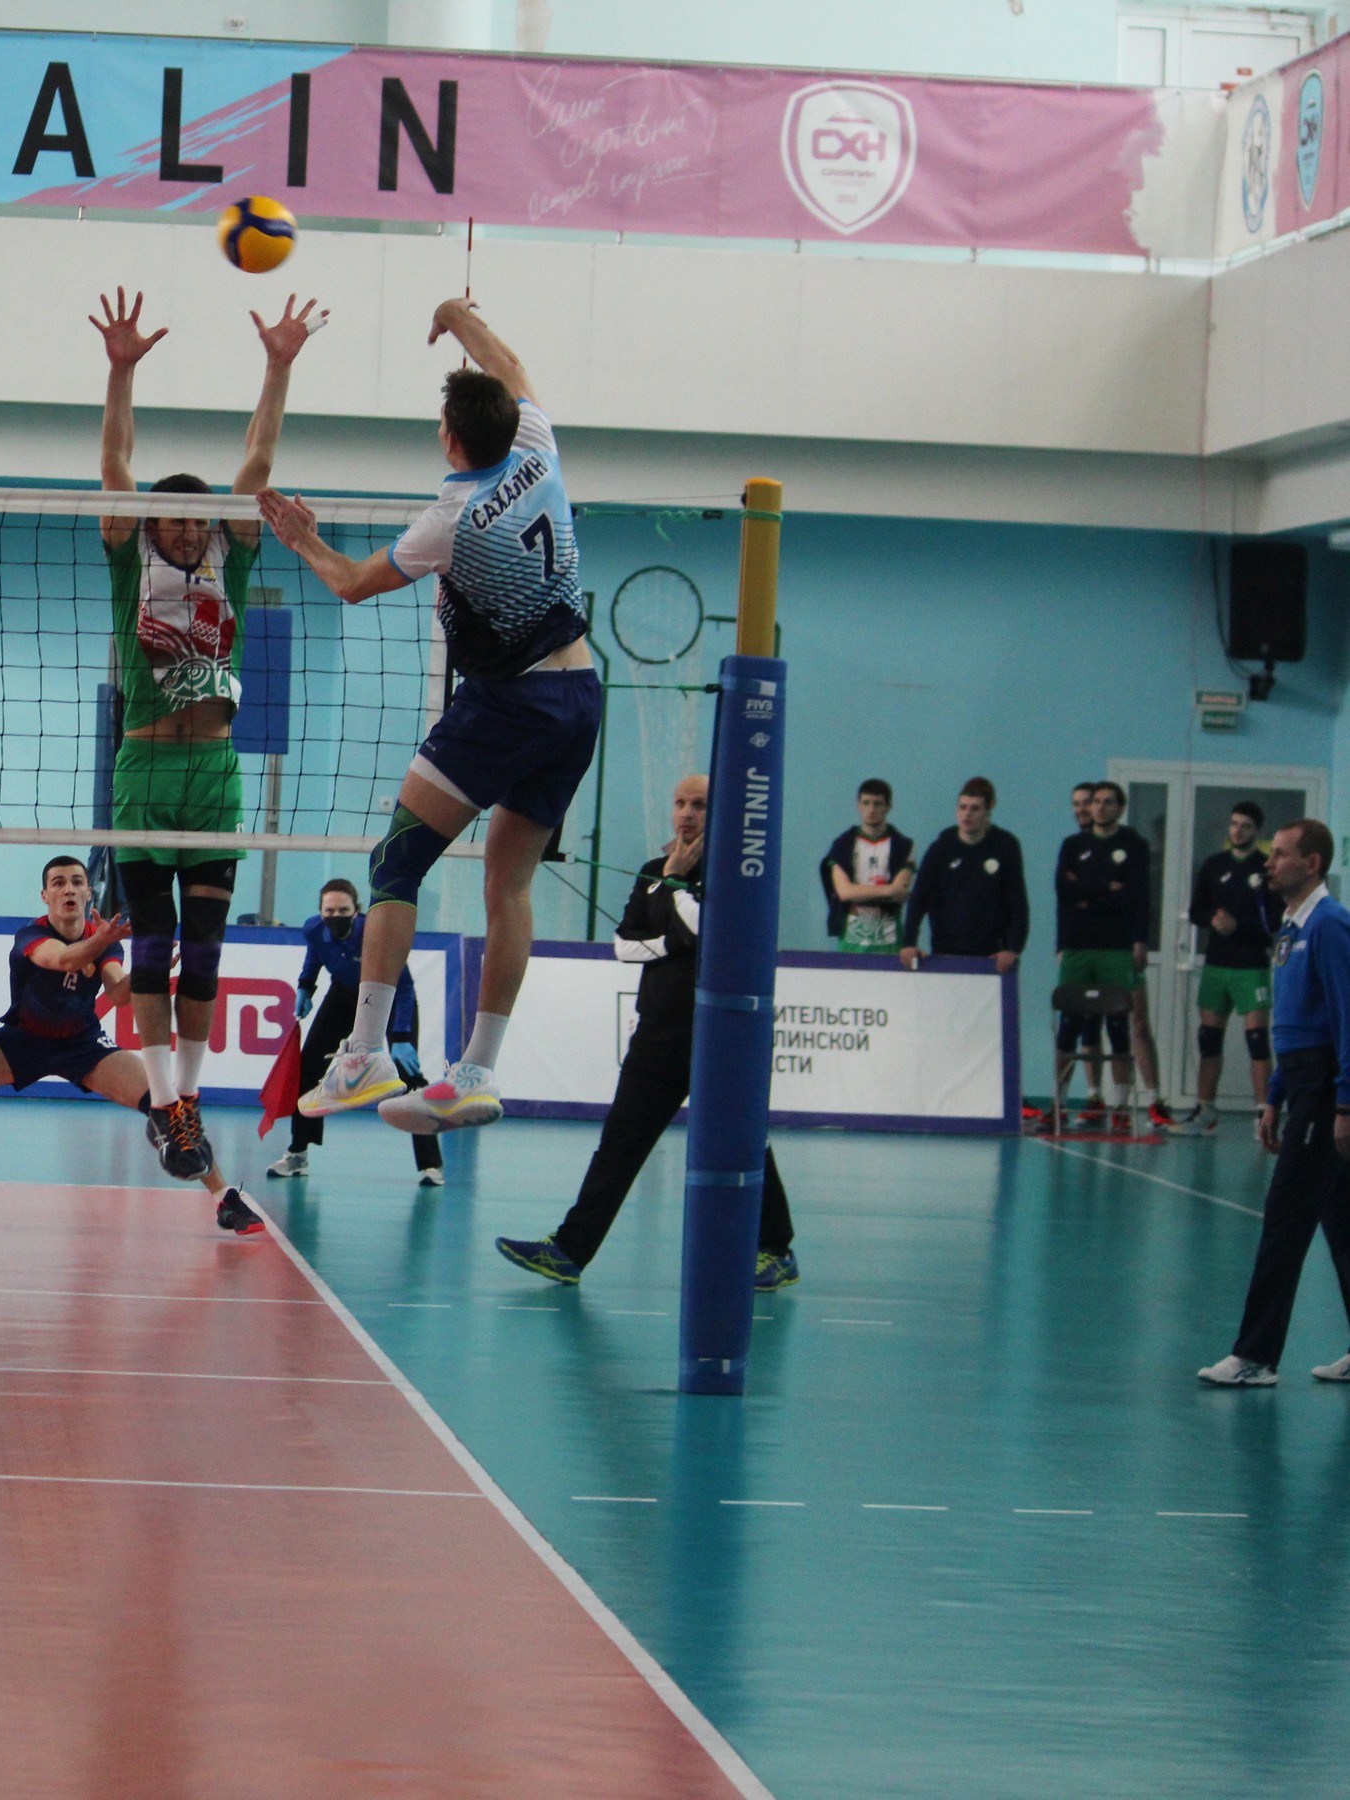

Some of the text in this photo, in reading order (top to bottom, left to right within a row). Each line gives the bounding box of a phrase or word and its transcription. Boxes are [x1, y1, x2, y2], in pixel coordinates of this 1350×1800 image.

[471, 455, 548, 530] САХАЛИН
[519, 511, 556, 583] 7
[741, 767, 770, 878] JINLING
